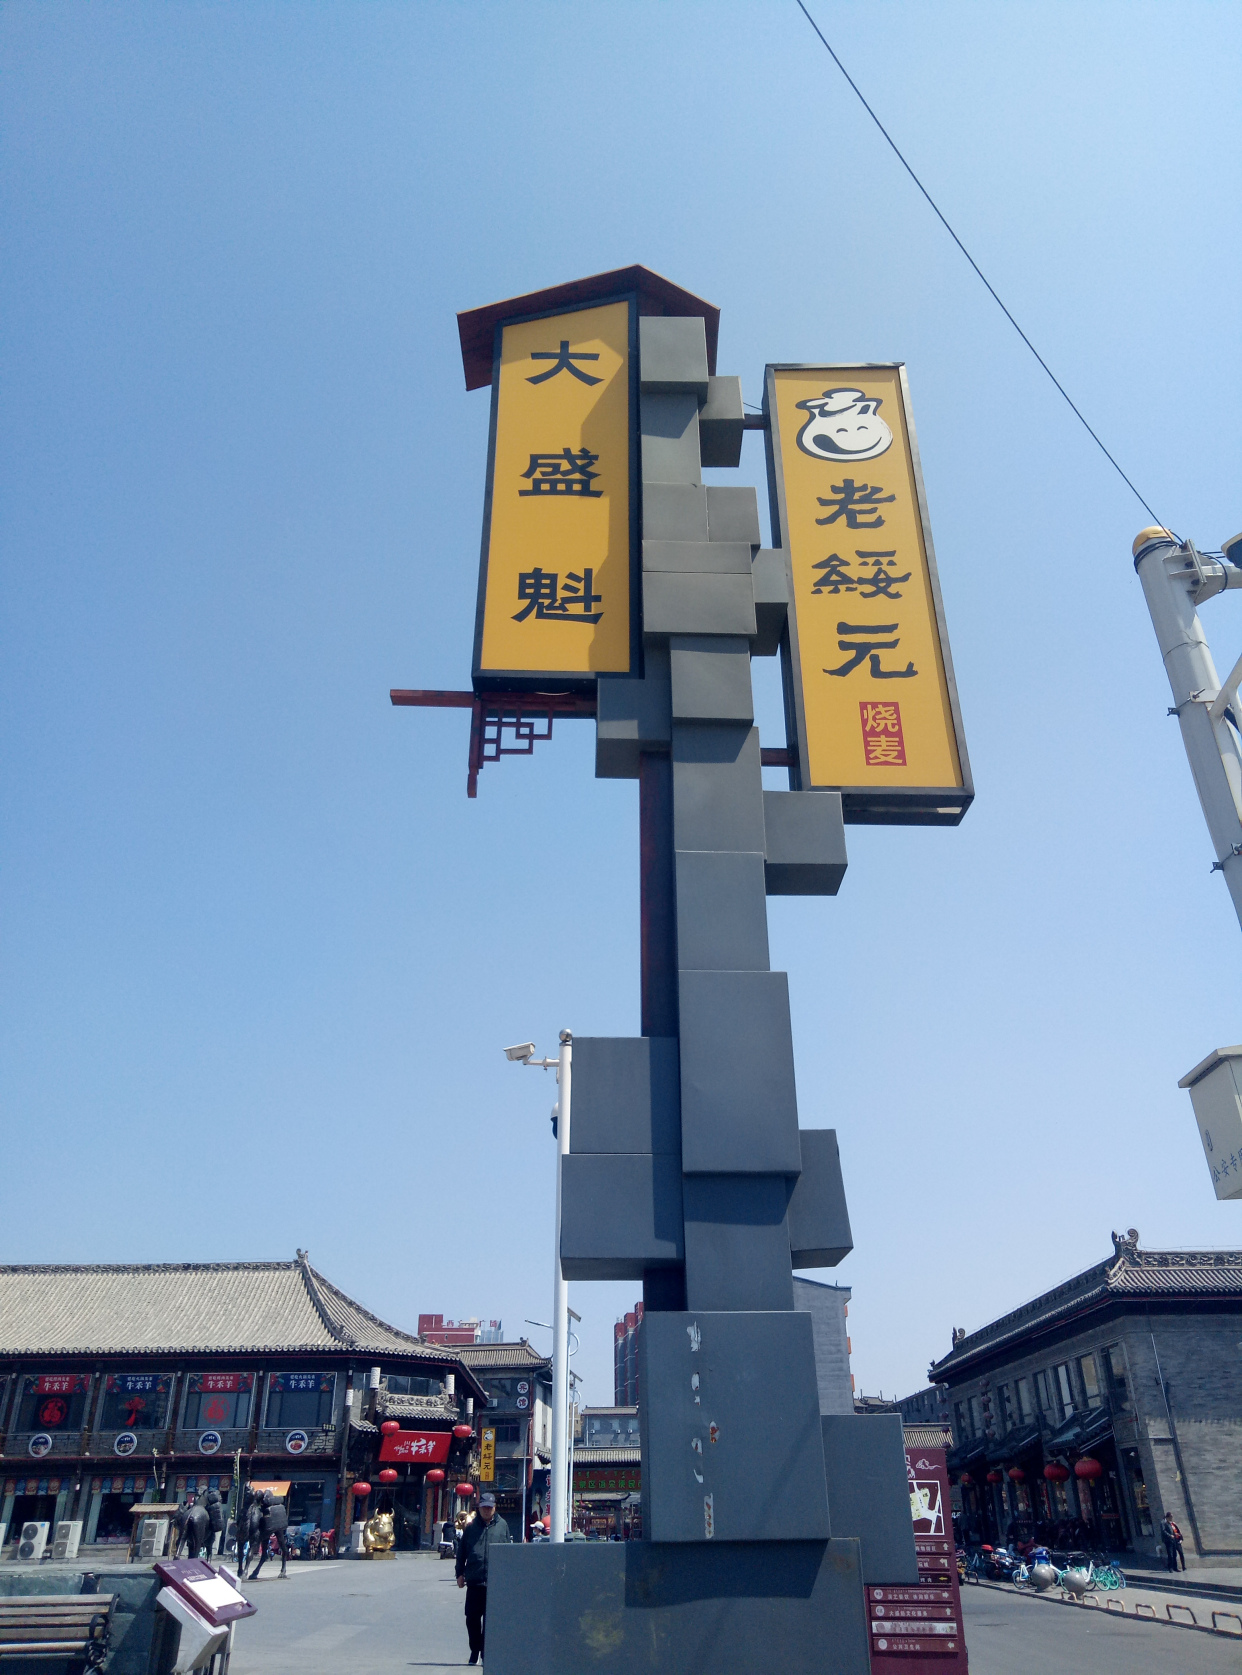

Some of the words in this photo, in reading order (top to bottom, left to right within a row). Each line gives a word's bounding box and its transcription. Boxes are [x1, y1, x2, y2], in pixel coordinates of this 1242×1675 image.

[510, 340, 606, 625] 大盛魁
[863, 704, 903, 764] 烧麦
